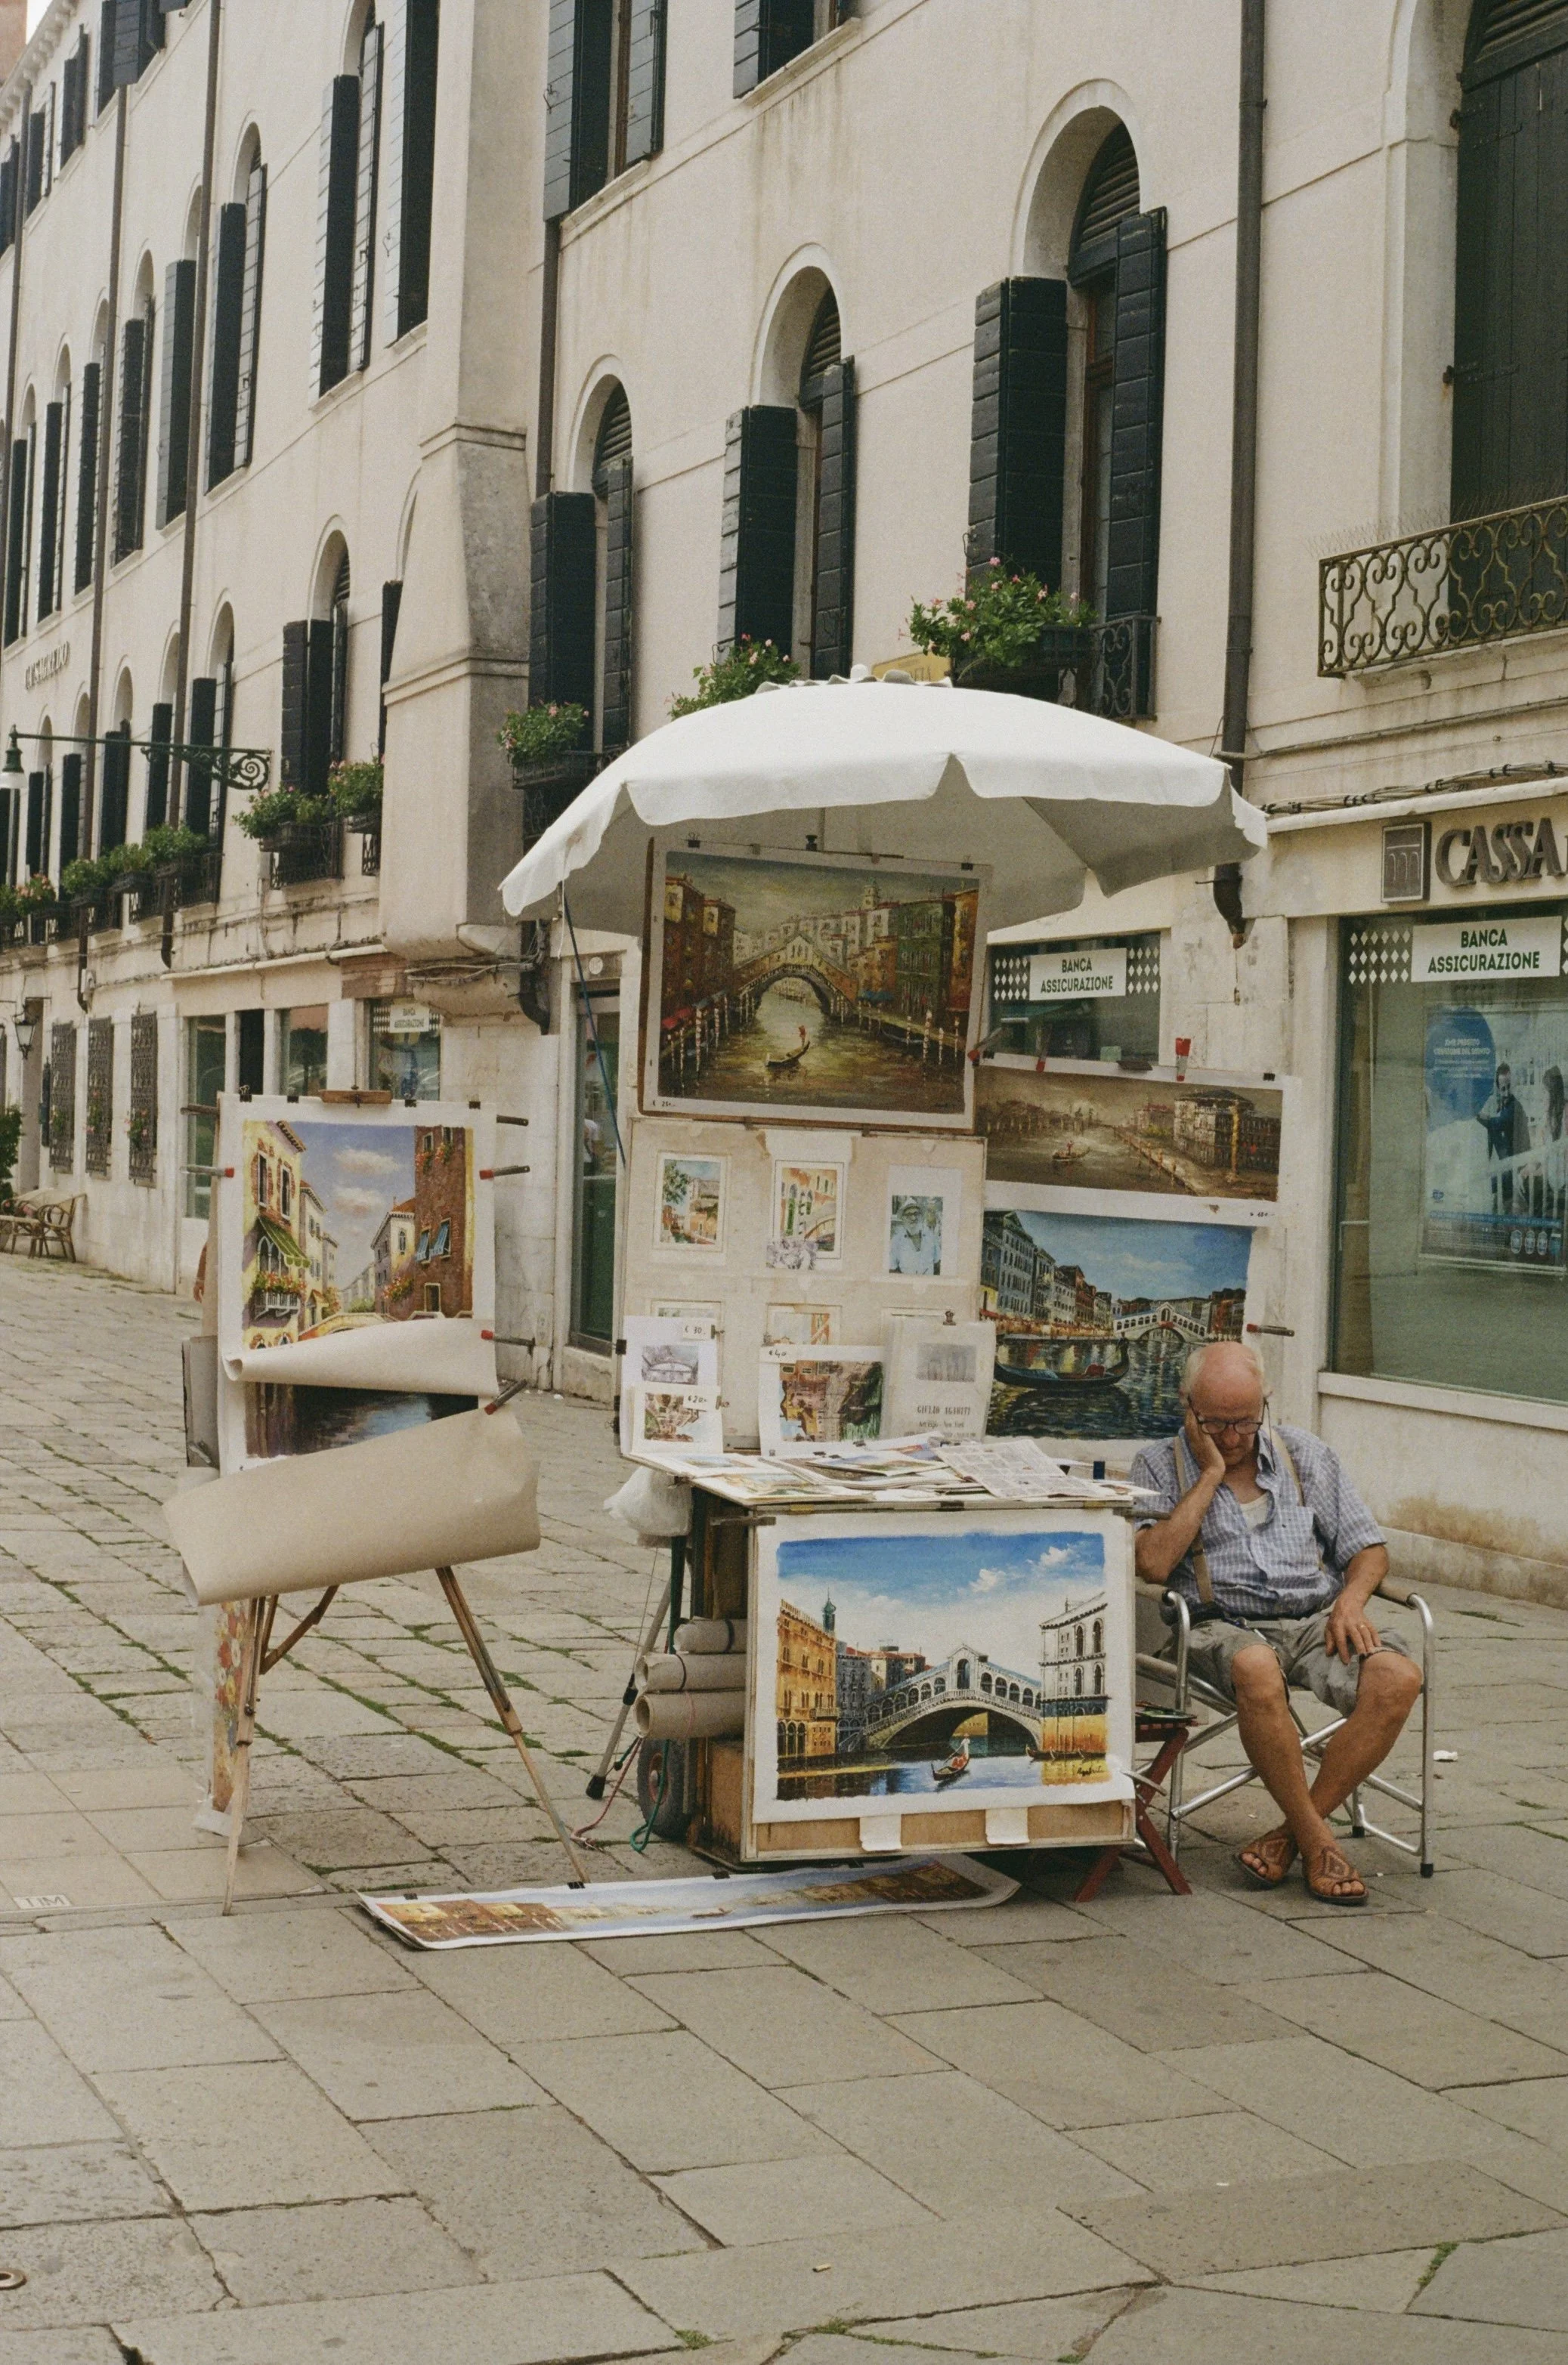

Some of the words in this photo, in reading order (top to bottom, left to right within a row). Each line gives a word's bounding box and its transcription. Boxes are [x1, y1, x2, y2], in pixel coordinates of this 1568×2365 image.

[1436, 818, 1566, 887] CASSA
[1461, 929, 1508, 948] BANCA
[1062, 957, 1092, 972] BANCA
[1428, 951, 1539, 972] ASSICURAZIONE
[1041, 976, 1112, 993] ASSICURAZIONE
